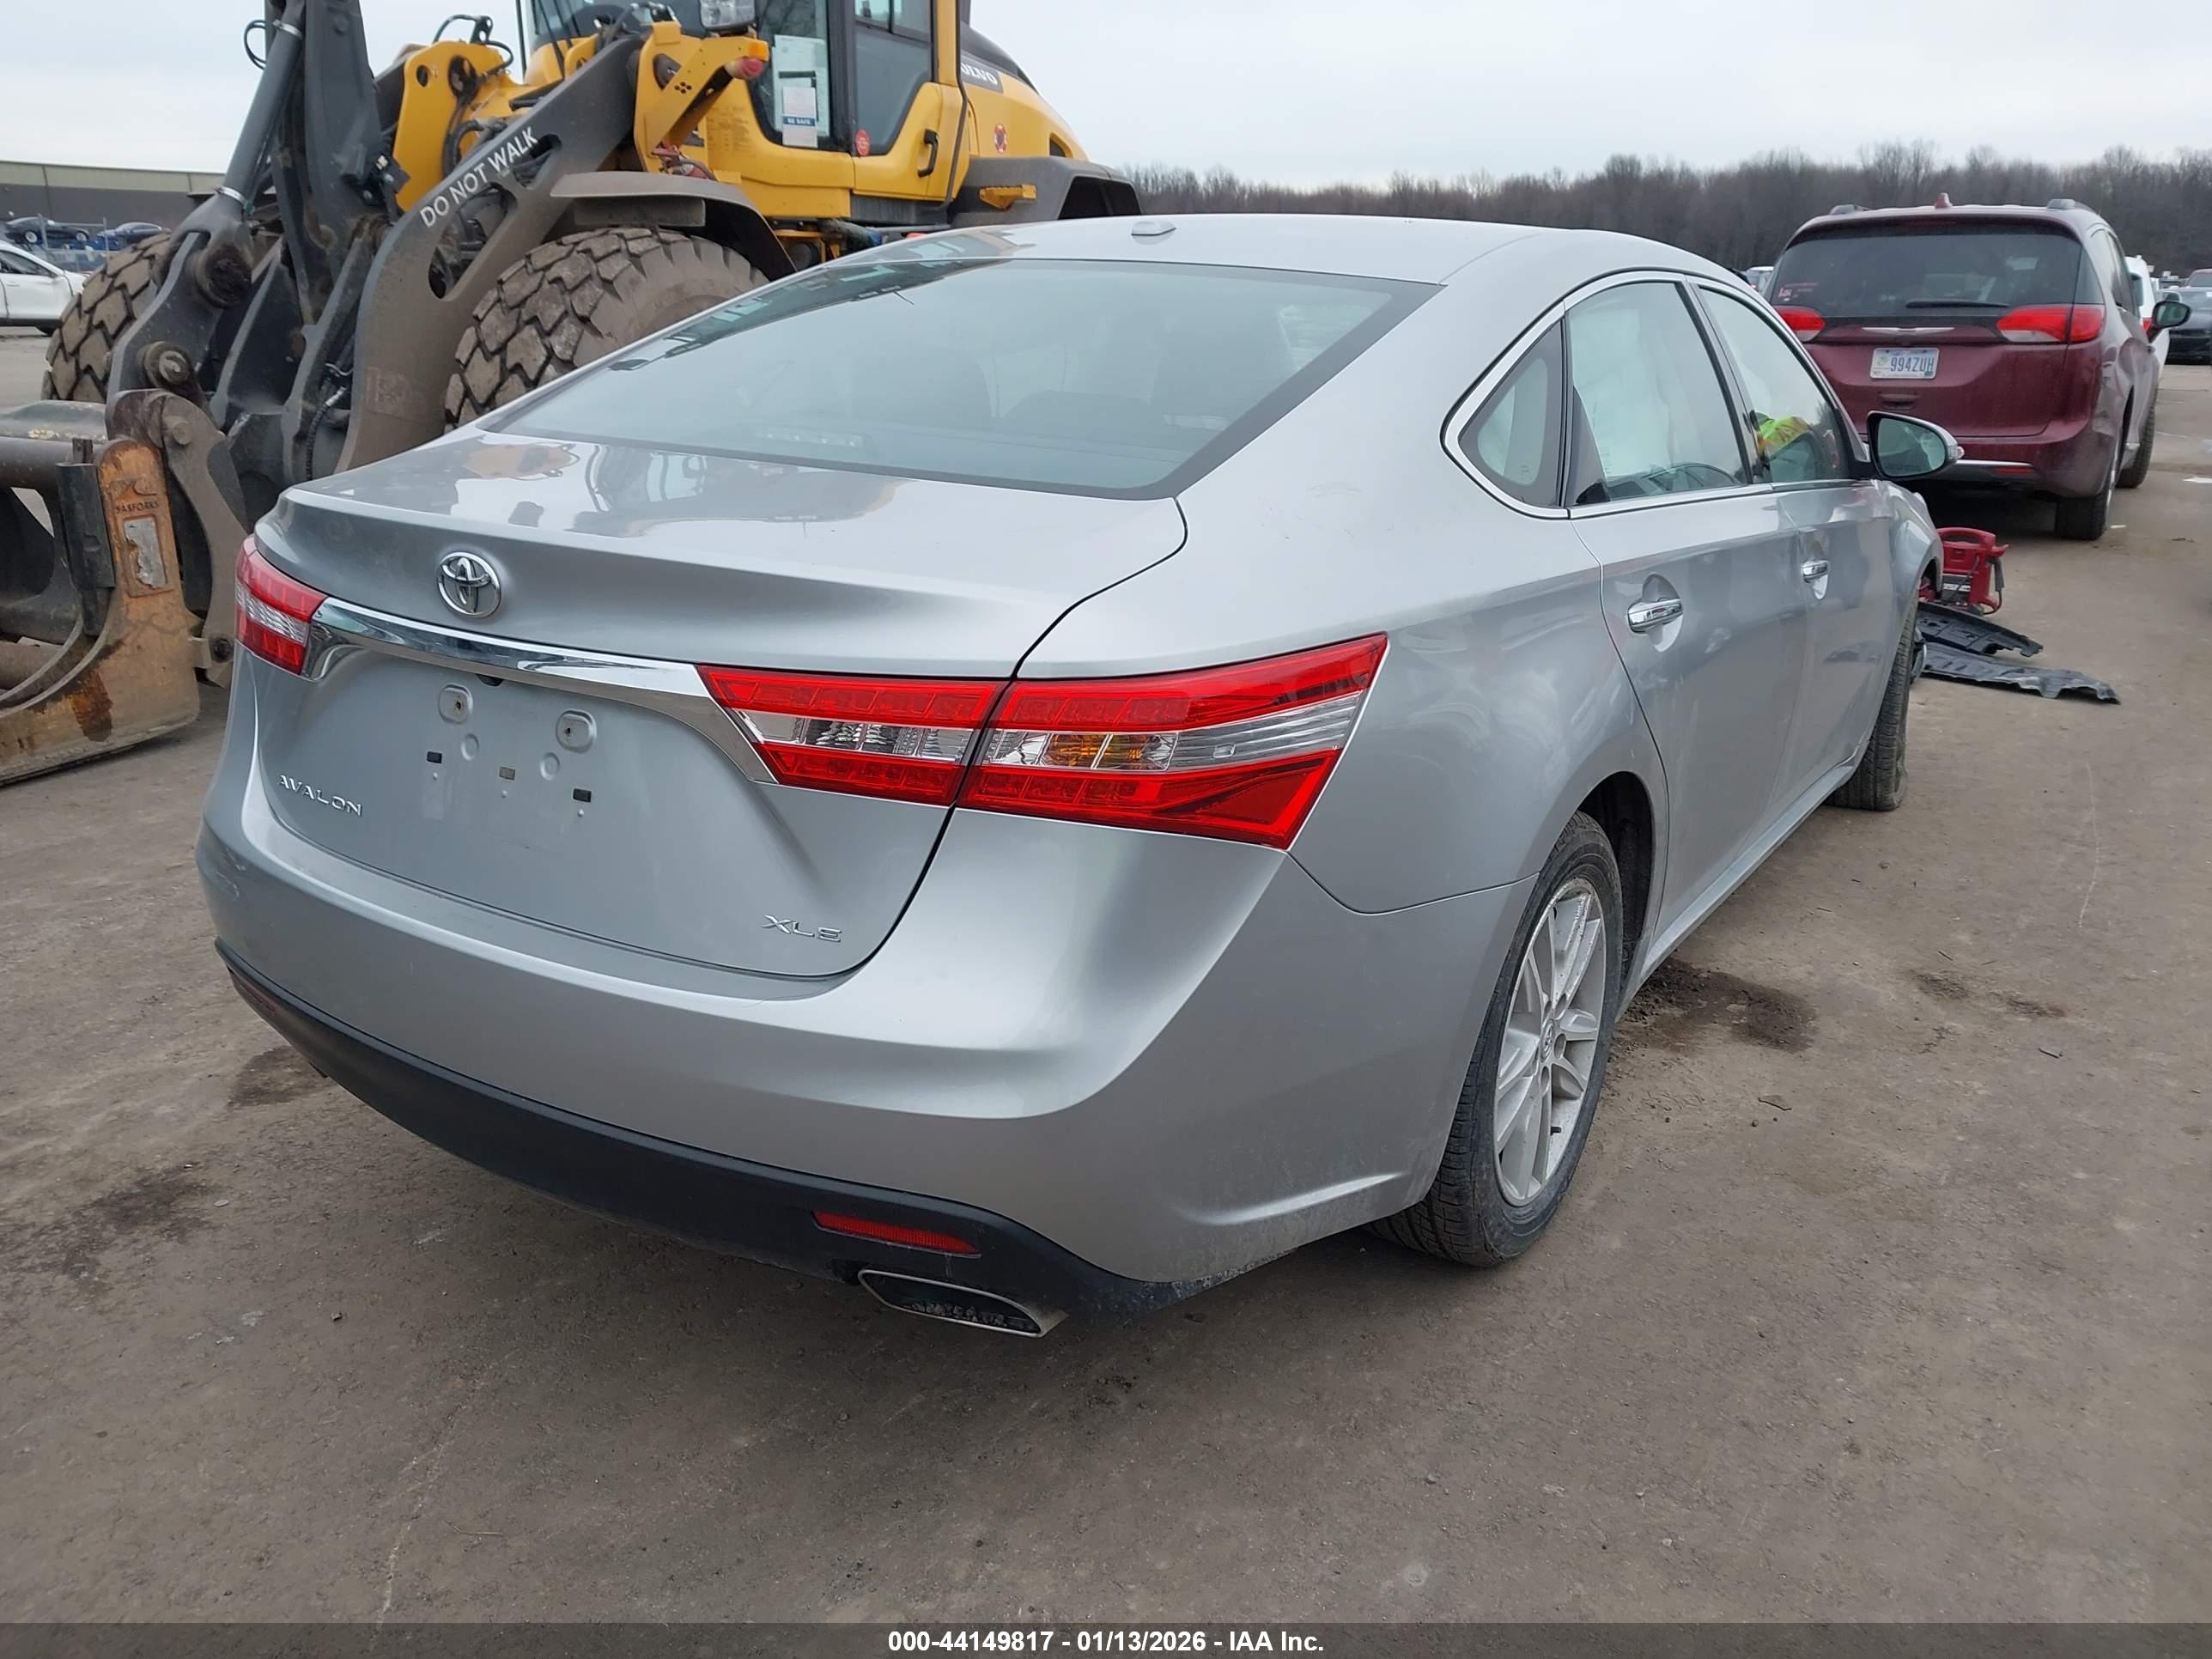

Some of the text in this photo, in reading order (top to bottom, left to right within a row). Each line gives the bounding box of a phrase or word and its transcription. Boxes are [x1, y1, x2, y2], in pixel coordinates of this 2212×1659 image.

[960, 62, 998, 84] OLVO
[419, 126, 538, 228] DO NOT WALK
[1890, 356, 1935, 372] 994ZUH
[277, 775, 362, 817] AVALON
[762, 915, 842, 943] XLE
